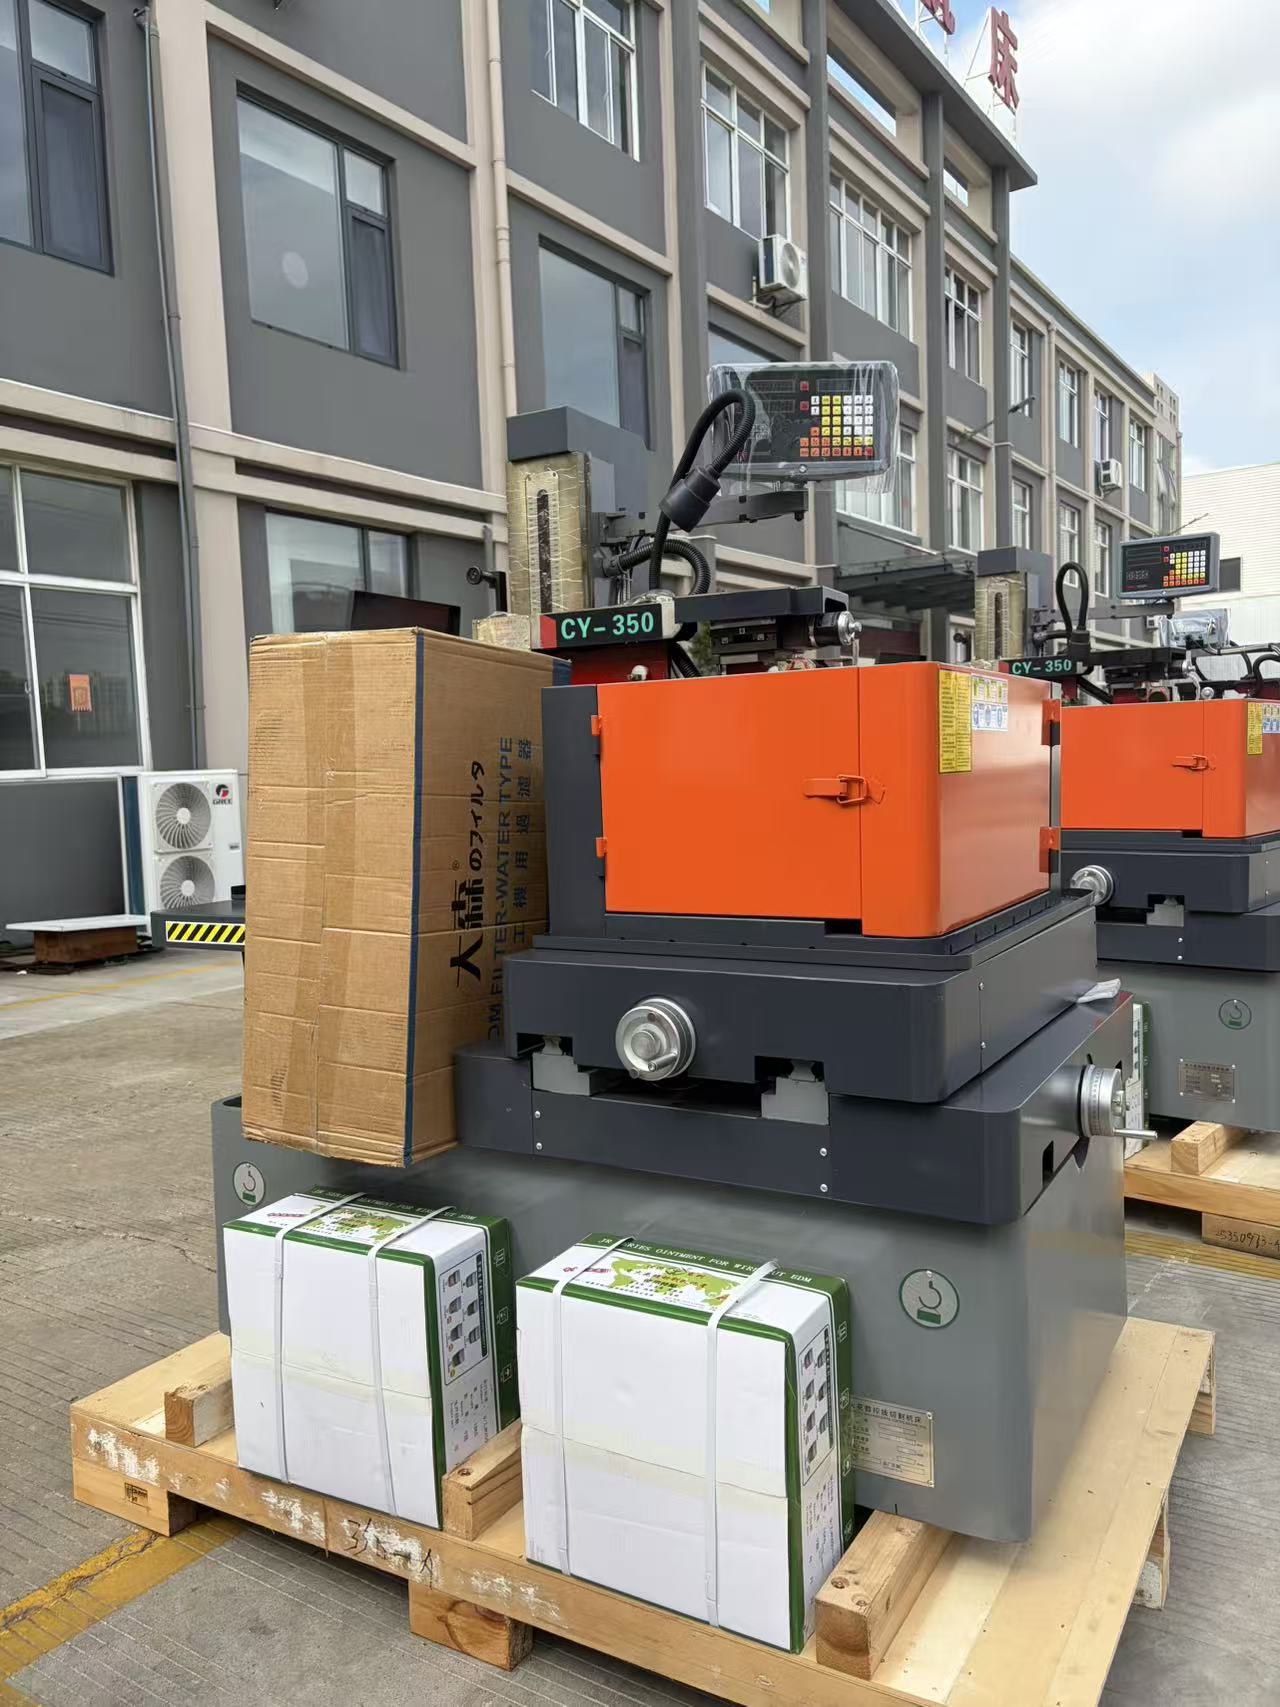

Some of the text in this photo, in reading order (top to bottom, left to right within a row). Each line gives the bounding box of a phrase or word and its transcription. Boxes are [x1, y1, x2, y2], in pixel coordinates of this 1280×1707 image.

[498, 736, 513, 805] TYPE
[655, 1248, 705, 1261] OINTMENT
[709, 1258, 729, 1267] FOR
[790, 1274, 812, 1283] EDM
